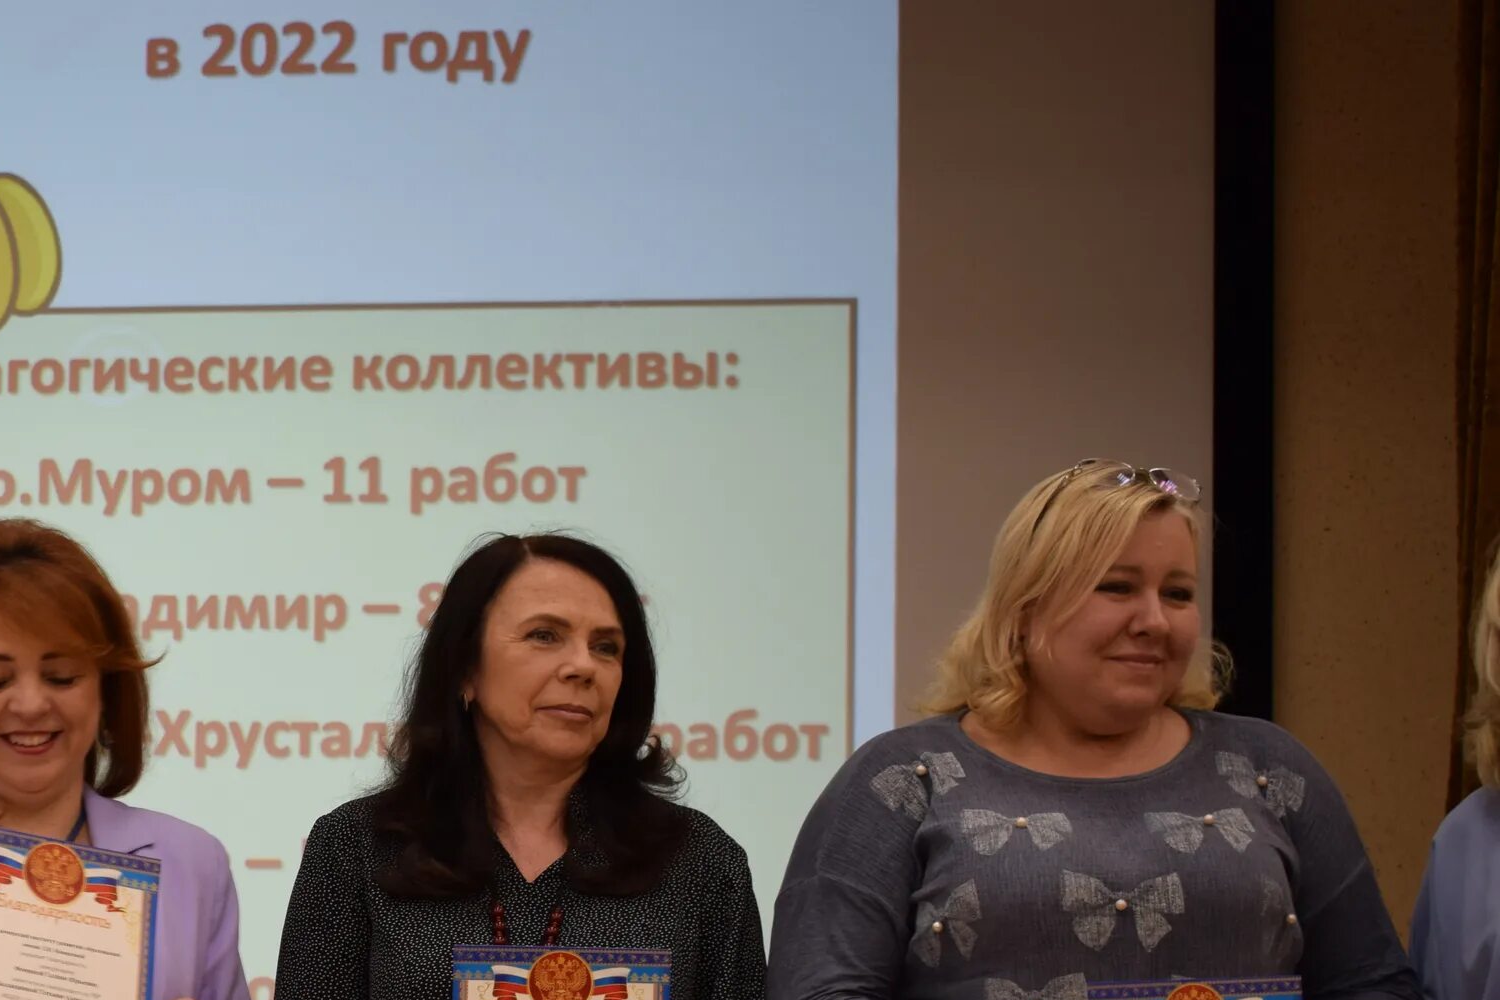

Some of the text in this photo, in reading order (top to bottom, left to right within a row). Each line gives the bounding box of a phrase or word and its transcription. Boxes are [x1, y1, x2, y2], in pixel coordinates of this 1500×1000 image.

[146, 20, 531, 84] в 2022 году
[351, 350, 740, 393] коллективы:
[322, 456, 388, 504] 11
[409, 451, 588, 516] работ
